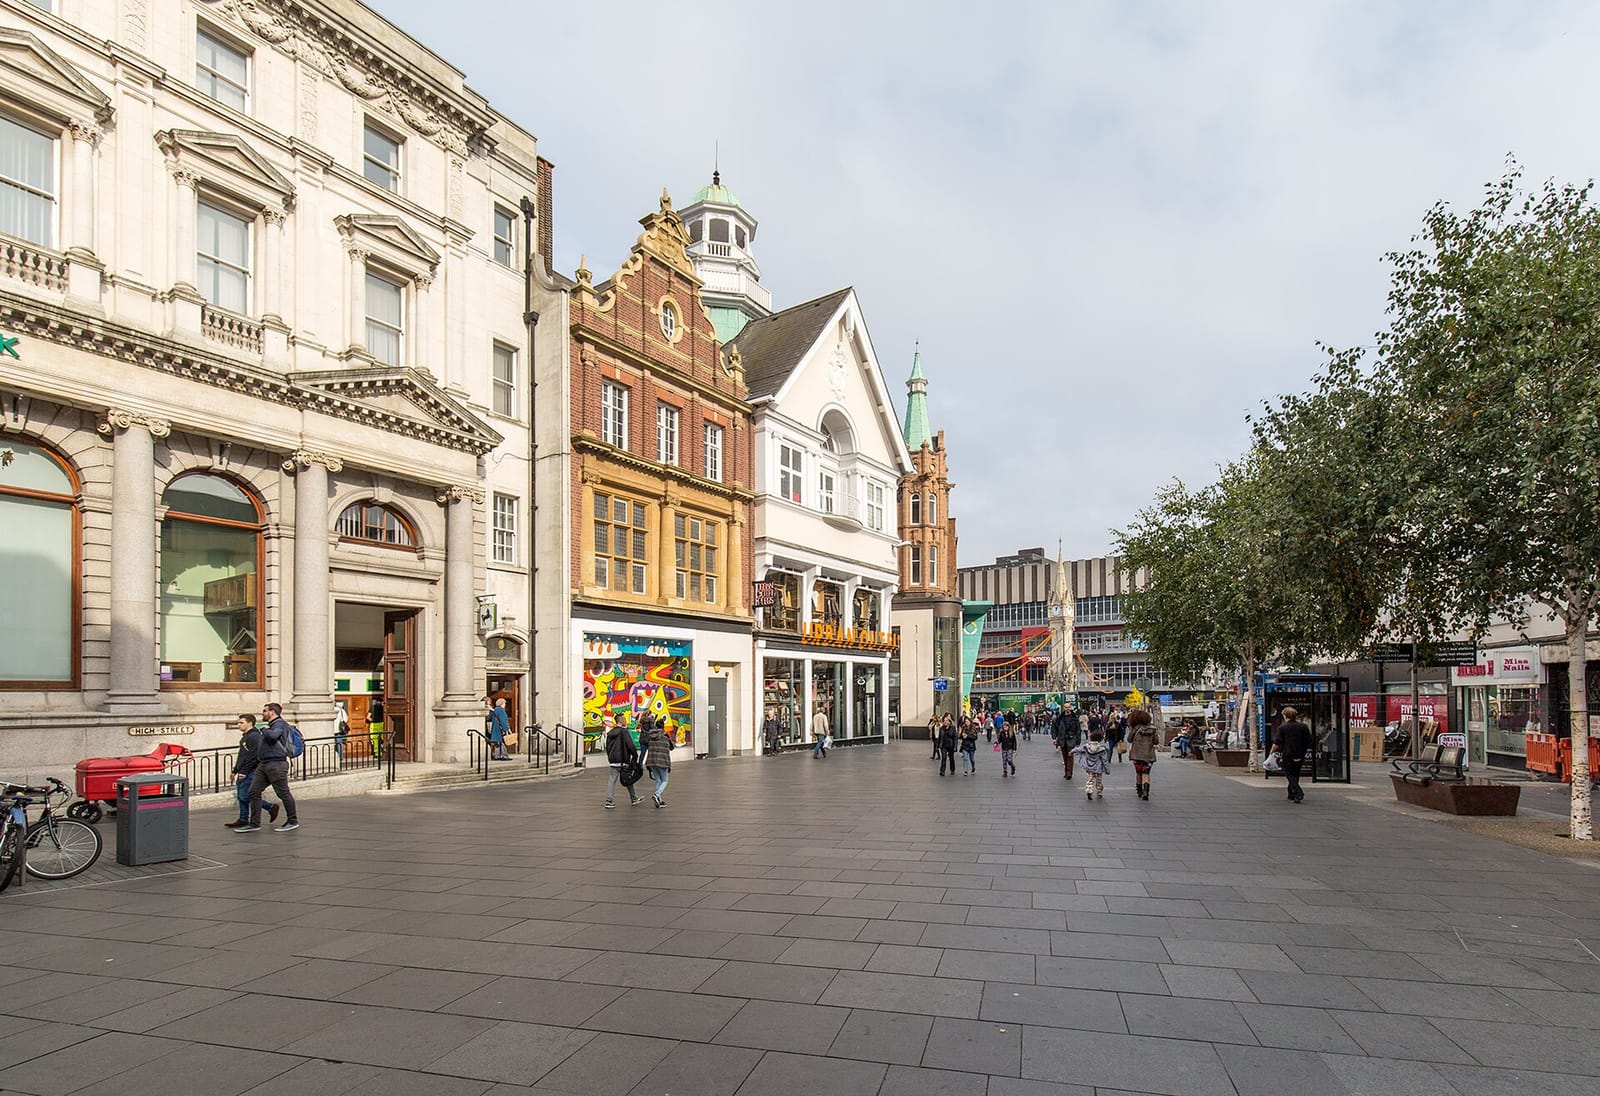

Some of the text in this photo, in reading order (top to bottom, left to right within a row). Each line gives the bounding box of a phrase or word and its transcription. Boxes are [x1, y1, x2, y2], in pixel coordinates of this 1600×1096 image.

[802, 621, 857, 647] URBAN
[1350, 702, 1368, 718] FIVE
[1419, 704, 1434, 716] UYS
[160, 726, 190, 734] STREET
